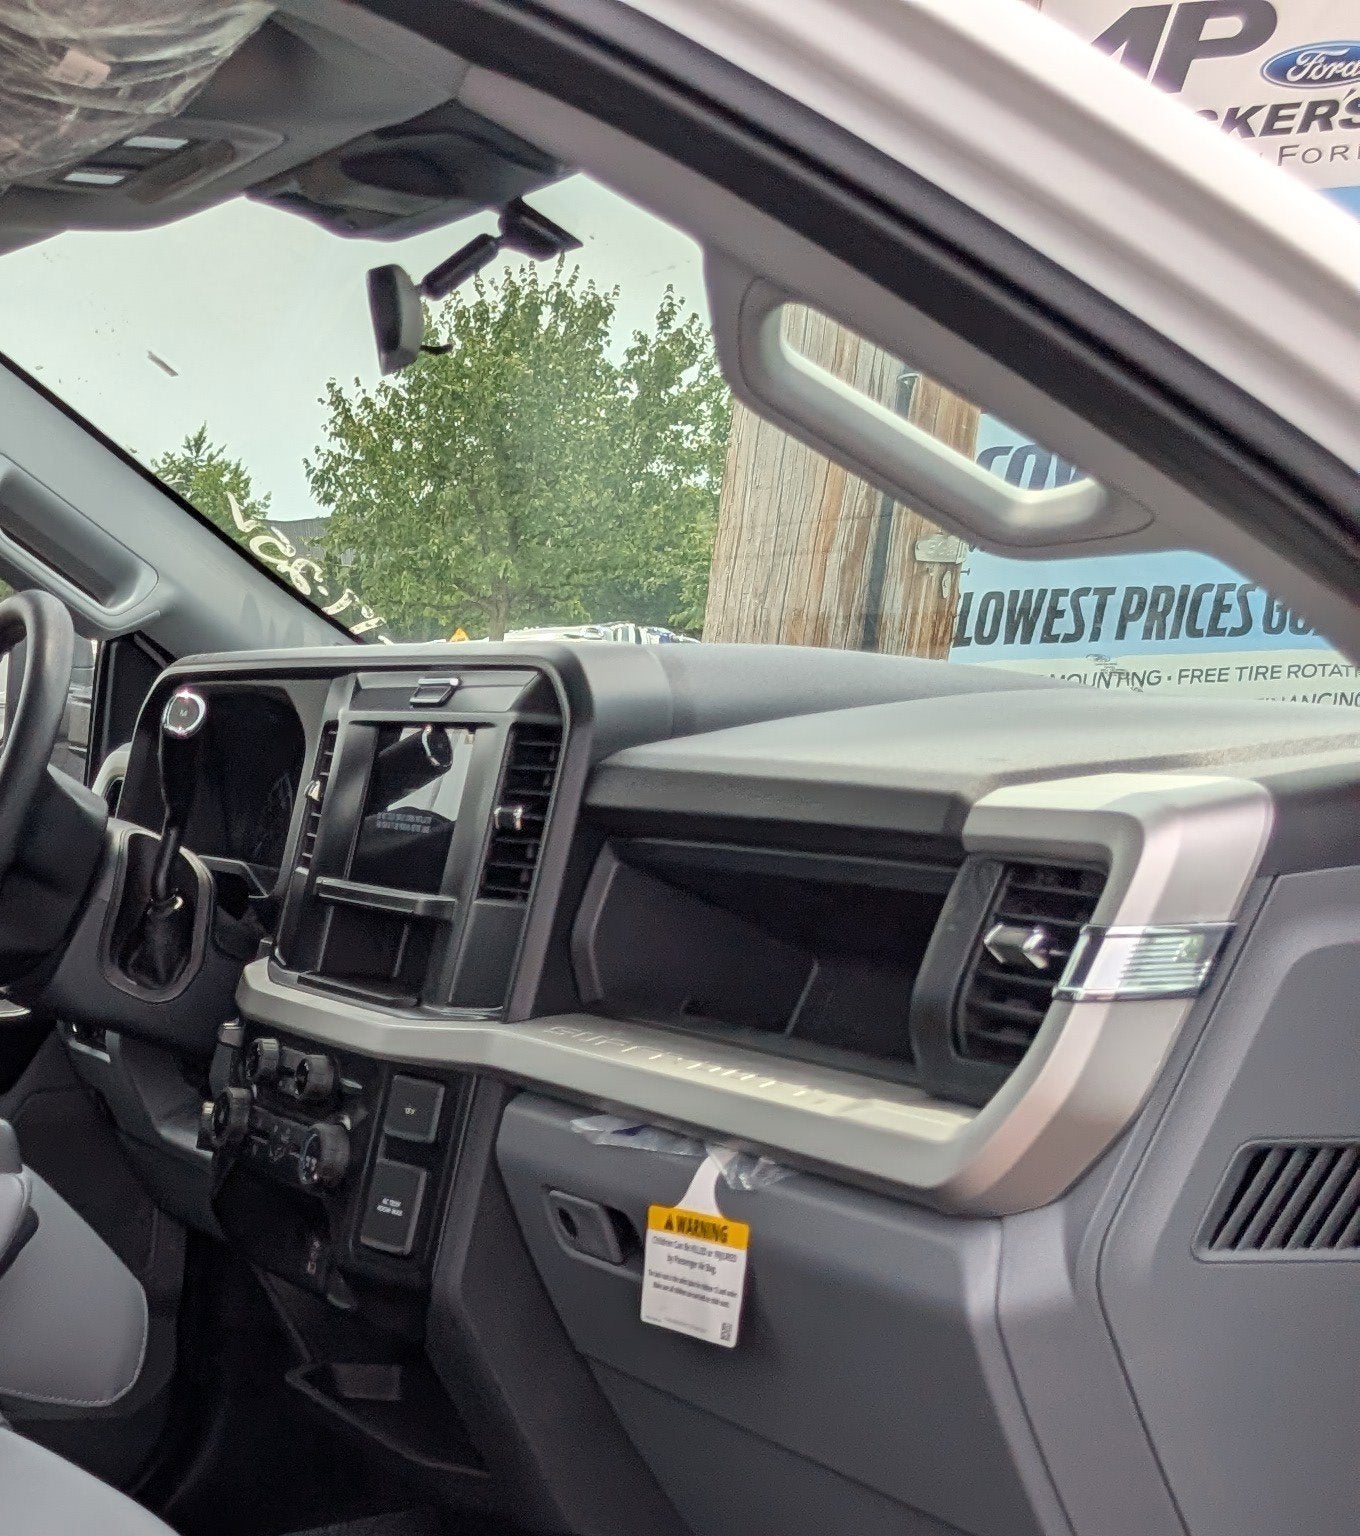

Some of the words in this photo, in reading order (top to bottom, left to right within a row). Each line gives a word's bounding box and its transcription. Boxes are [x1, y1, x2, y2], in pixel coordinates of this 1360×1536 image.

[1277, 144, 1360, 167] FOR
[953, 586, 1116, 648] LOWEST
[1115, 583, 1258, 641] PRICES
[1177, 666, 1230, 685] FREE
[1235, 664, 1282, 682] TIRE
